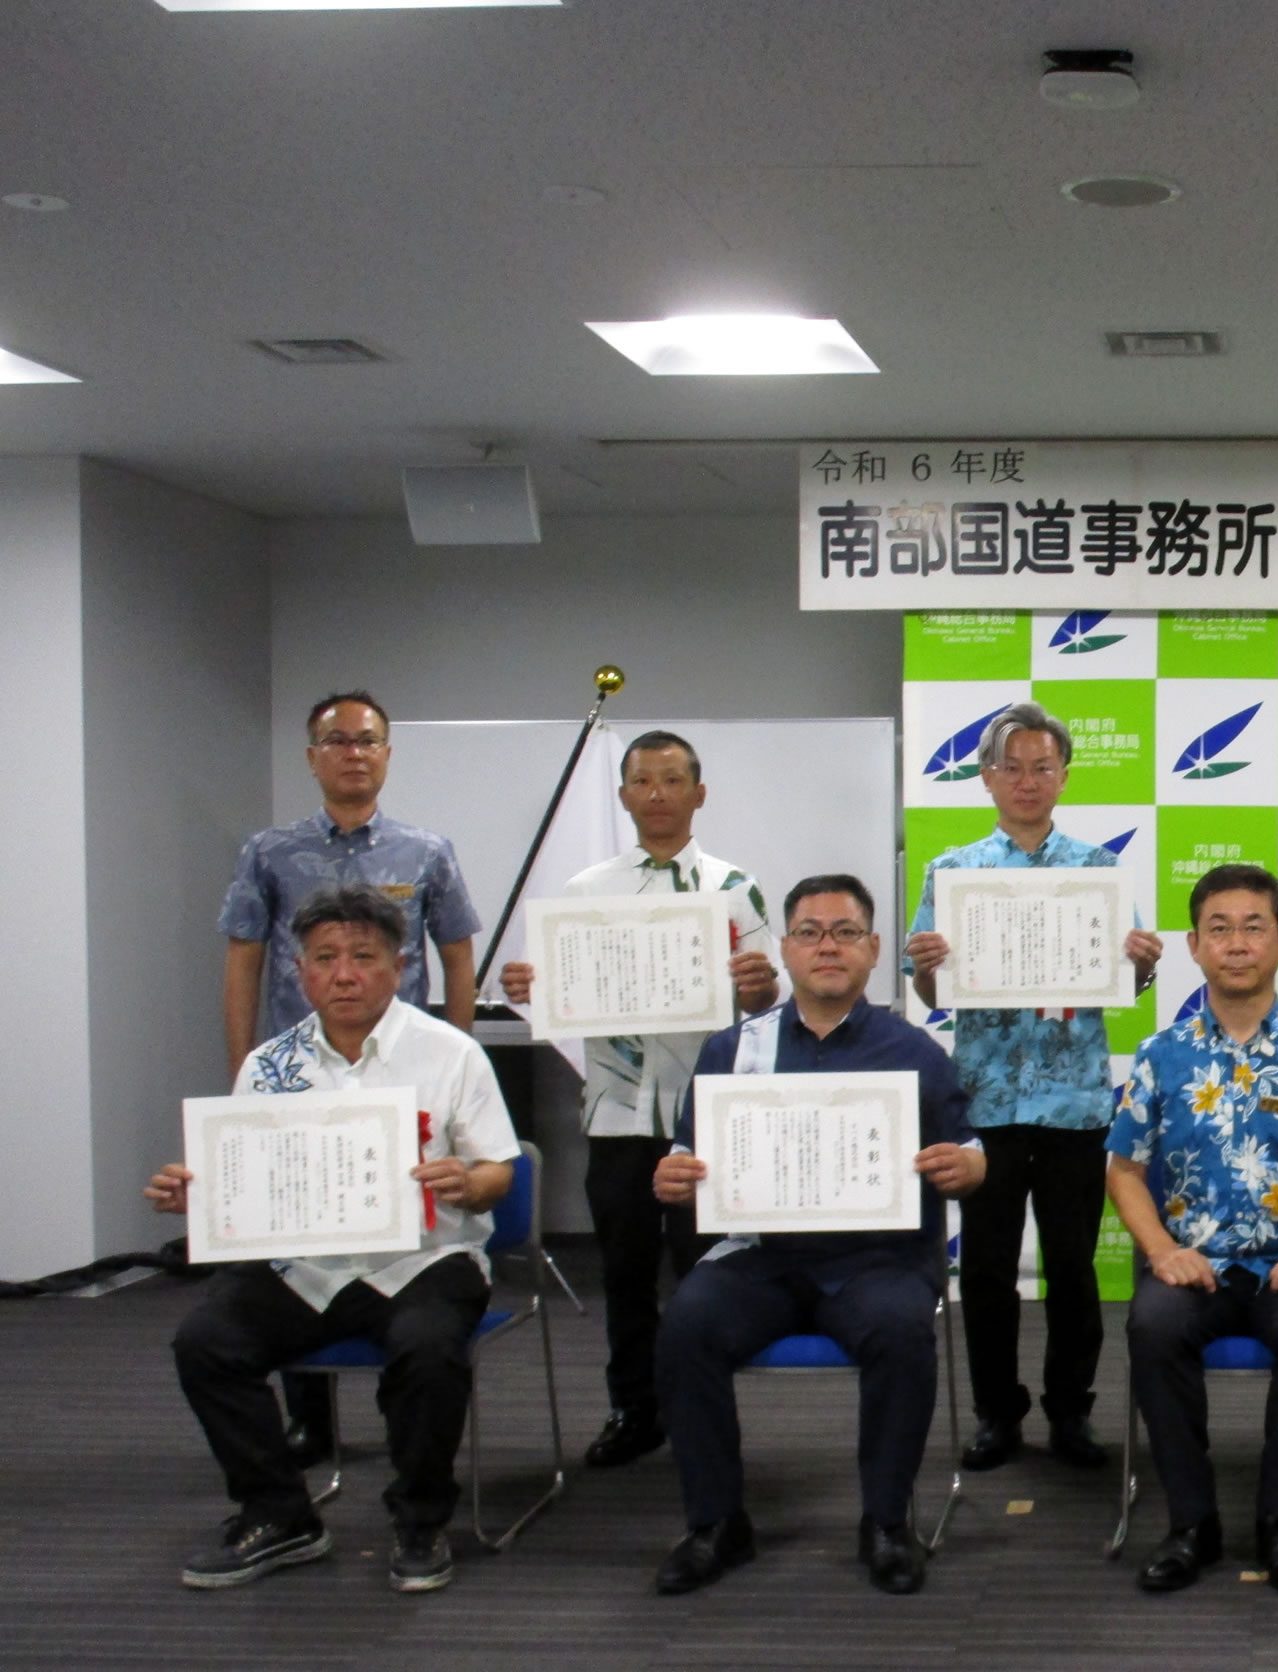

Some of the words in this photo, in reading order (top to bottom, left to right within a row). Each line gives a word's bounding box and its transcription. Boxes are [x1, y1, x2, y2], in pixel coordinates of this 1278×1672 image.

[1069, 718, 1116, 733] 内閣府
[1194, 844, 1242, 859] 内閣府
